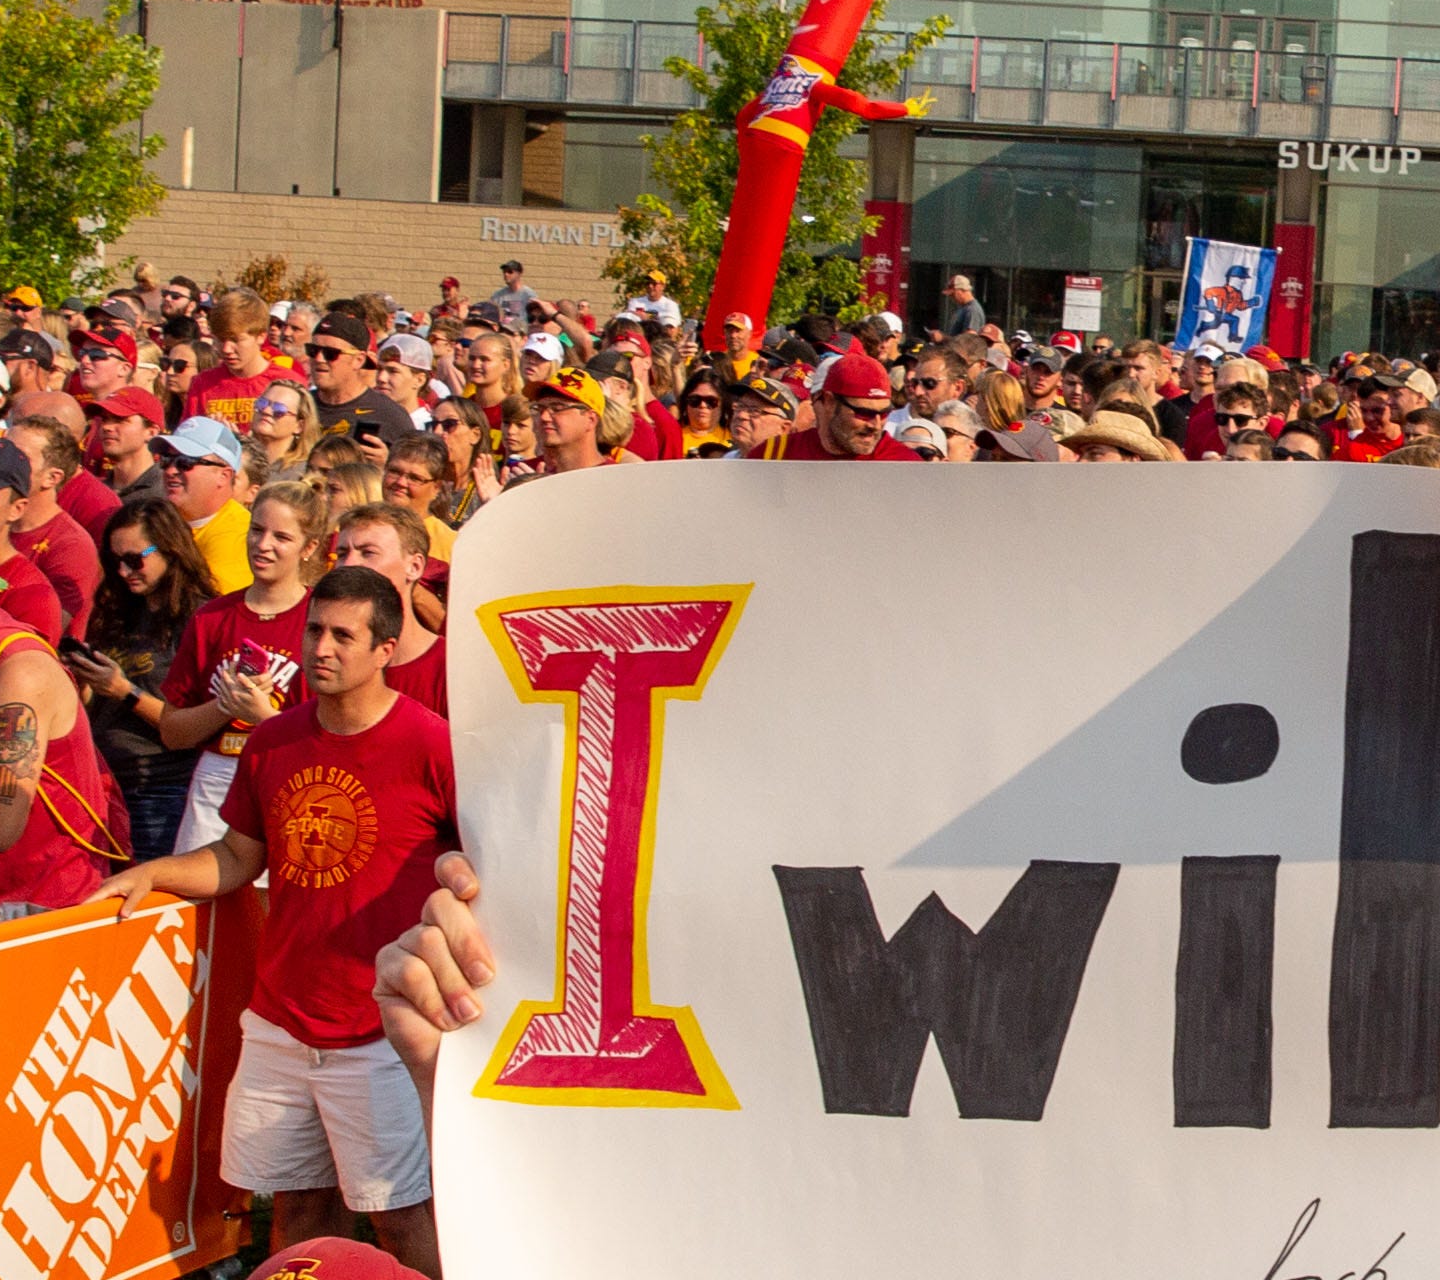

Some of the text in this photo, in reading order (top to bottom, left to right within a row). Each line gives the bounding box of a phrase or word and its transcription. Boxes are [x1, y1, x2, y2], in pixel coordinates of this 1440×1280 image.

[1278, 139, 1422, 176] SUKUP
[480, 217, 584, 247] REIMAN
[473, 581, 754, 1111] I
[5, 966, 104, 1128] THE
